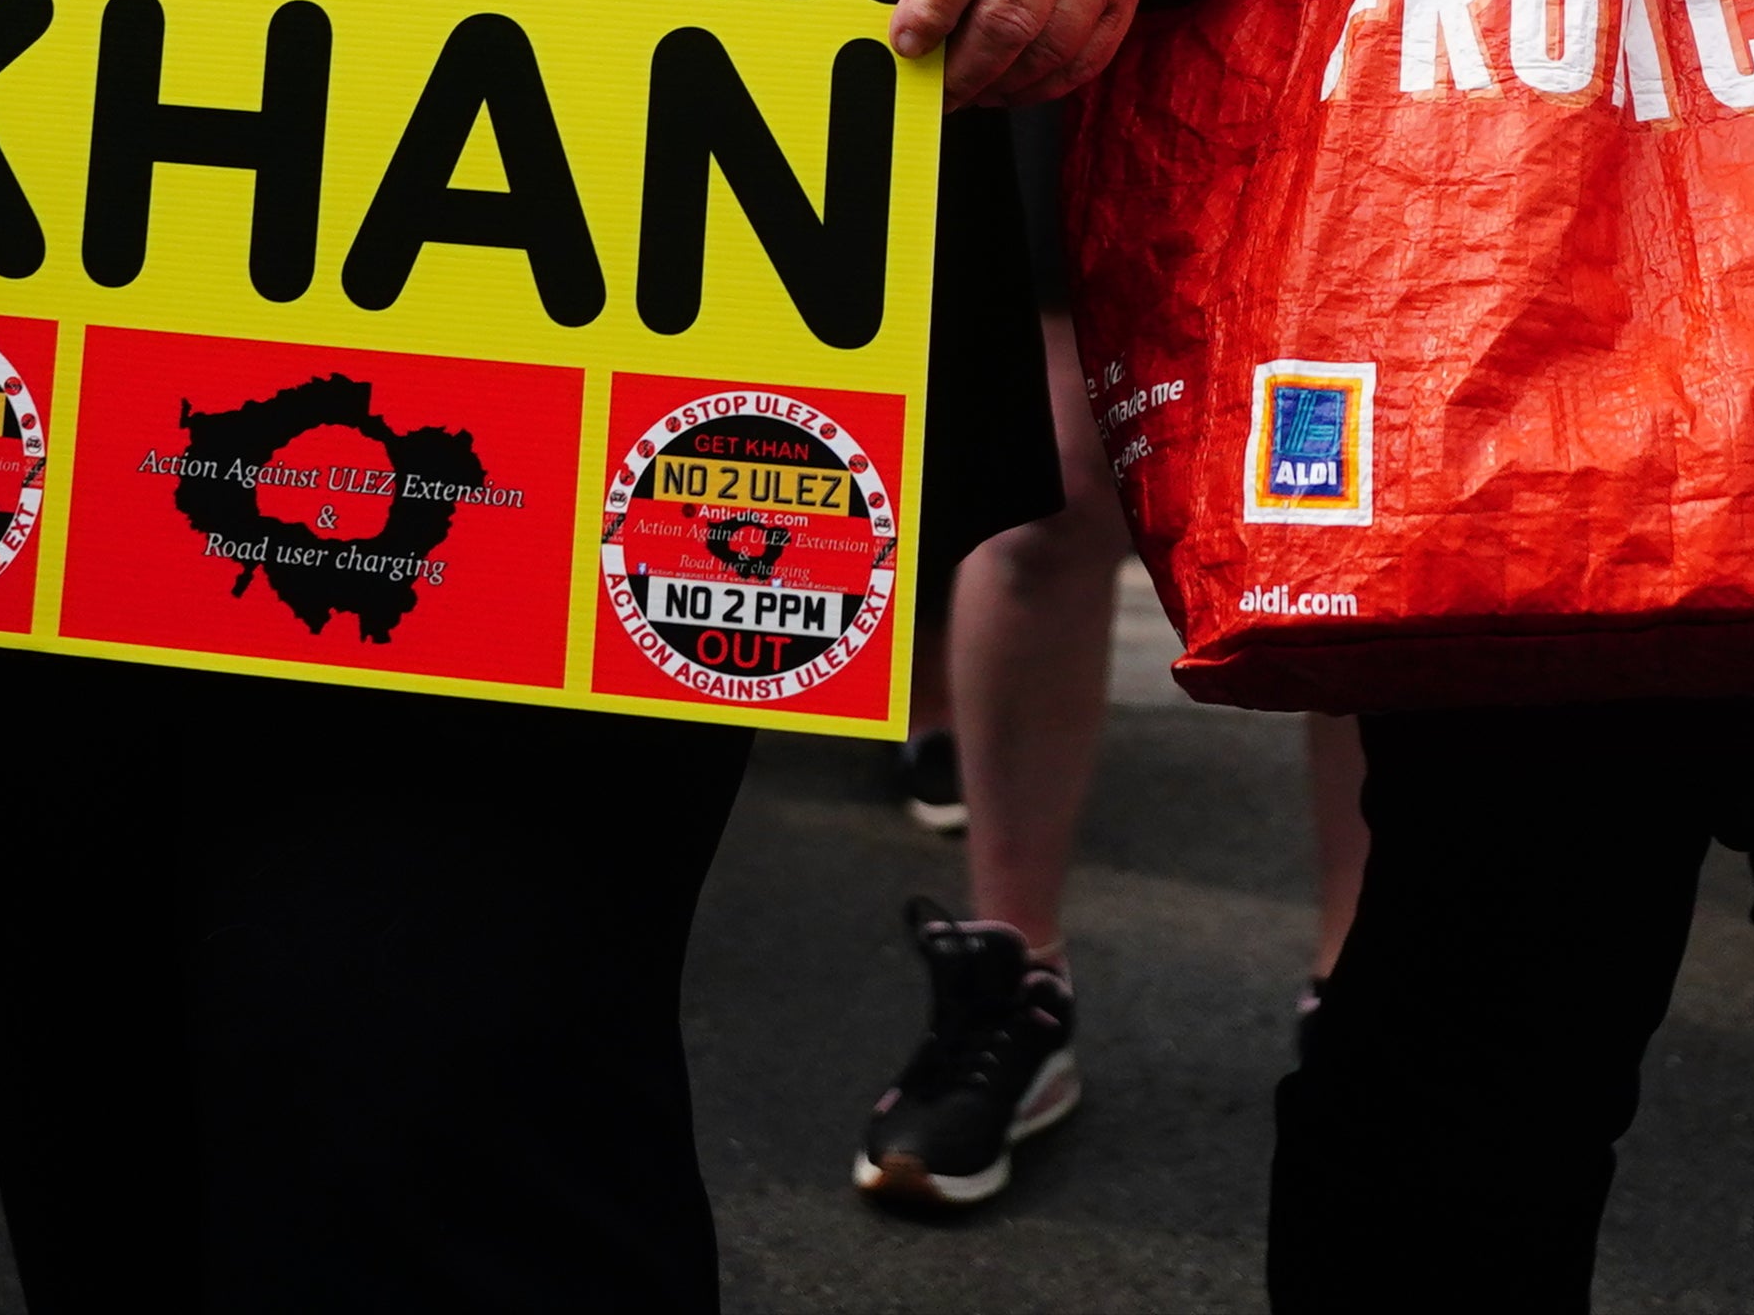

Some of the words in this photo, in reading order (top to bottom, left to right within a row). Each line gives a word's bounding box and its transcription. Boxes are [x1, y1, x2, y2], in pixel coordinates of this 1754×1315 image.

[1150, 379, 1185, 408] me
[682, 395, 747, 427] STOP
[755, 395, 819, 431] ULEZ
[695, 434, 739, 454] GET
[747, 436, 810, 461] KHAN
[139, 449, 218, 480] Action
[224, 457, 321, 489] Against
[327, 466, 397, 497] ULEZ
[401, 474, 525, 508] Extension
[663, 461, 708, 497] NO
[717, 467, 739, 500] 2
[749, 469, 843, 509] ULEZ
[1275, 460, 1337, 486] ALDI
[6, 503, 36, 558] EXT
[316, 505, 337, 529] &
[698, 504, 809, 528] Anti-ulez.com
[633, 519, 683, 537] Action
[686, 524, 746, 548] Against
[749, 529, 792, 547] ULEZ
[796, 533, 870, 554] Extension
[738, 546, 752, 561] &
[204, 533, 270, 562] Road
[276, 545, 329, 568] user
[335, 546, 447, 586] charging
[679, 554, 715, 570] Road
[718, 560, 747, 574] user
[750, 560, 811, 583] charging
[665, 583, 712, 620] NO
[722, 588, 746, 623] 2
[755, 592, 825, 631] PPM
[1239, 584, 1358, 616] aldi.com
[607, 573, 674, 667] ACTION
[674, 663, 786, 701] AGAINST
[797, 636, 860, 690] ULEZ
[855, 585, 888, 636] EXT
[697, 629, 792, 671] OUT
